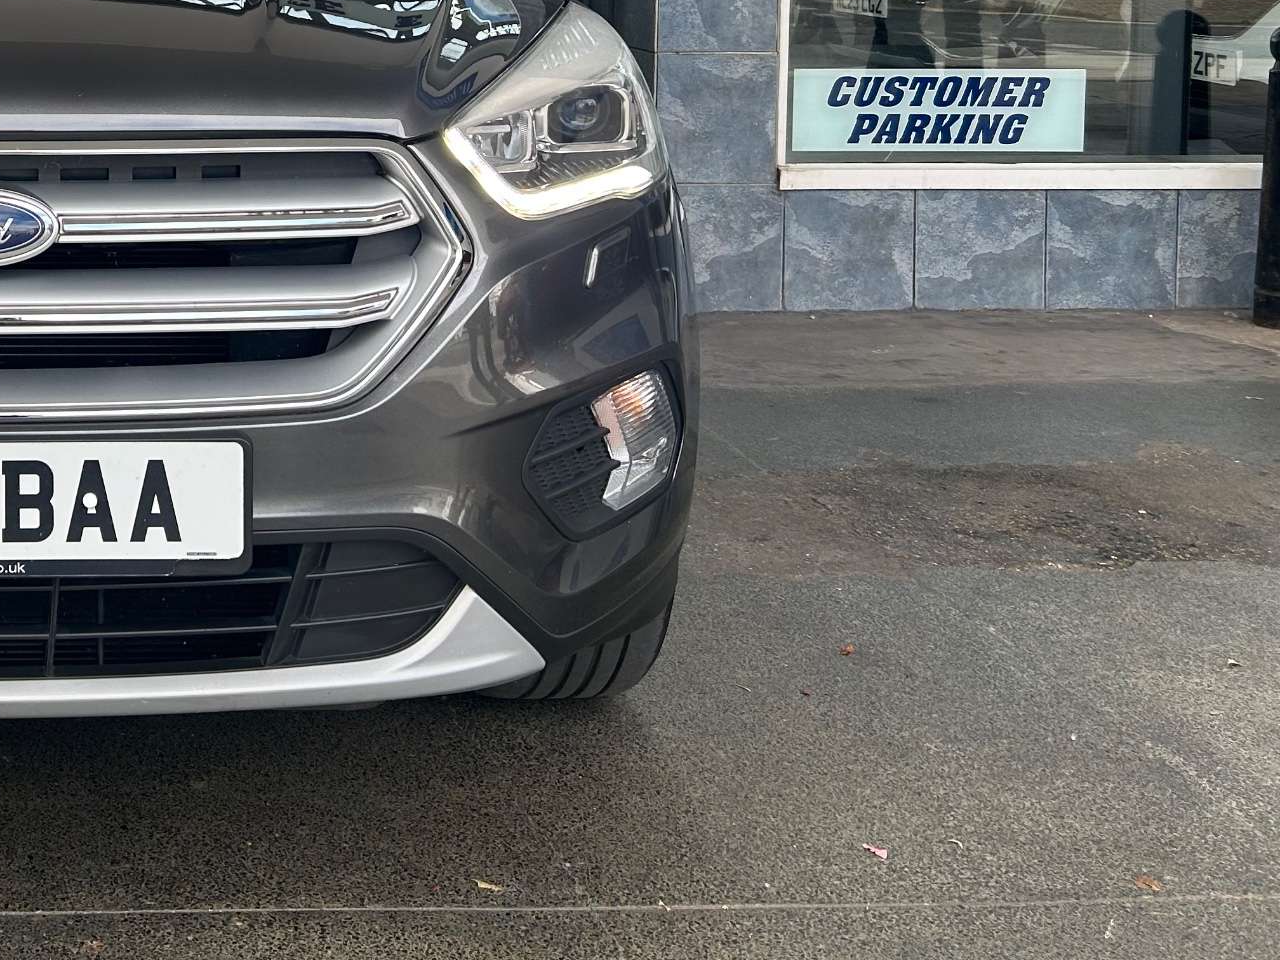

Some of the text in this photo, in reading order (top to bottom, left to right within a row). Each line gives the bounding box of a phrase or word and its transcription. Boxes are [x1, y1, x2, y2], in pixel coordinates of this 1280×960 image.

[1193, 50, 1228, 79] ZPF
[827, 76, 1051, 108] CUSTOMER
[847, 114, 1029, 145] PARKING
[1, 459, 182, 543] BAA
